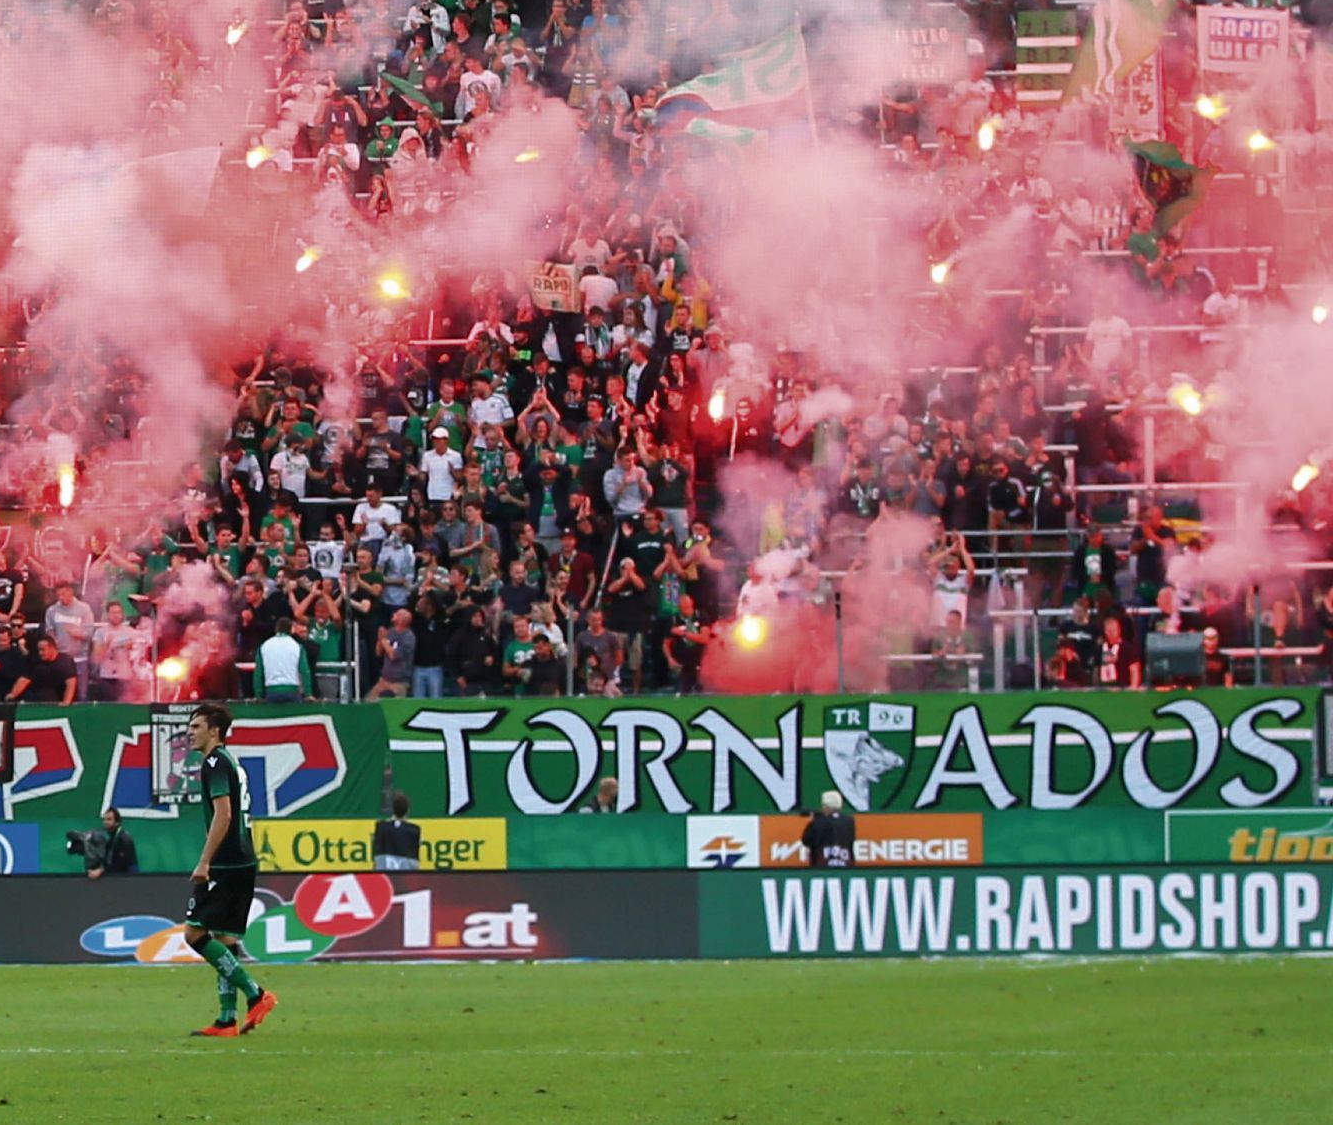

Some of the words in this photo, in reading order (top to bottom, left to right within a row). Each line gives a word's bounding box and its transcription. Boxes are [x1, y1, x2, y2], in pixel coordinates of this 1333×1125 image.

[1210, 17, 1279, 39] RAPID
[831, 708, 861, 725] TR
[291, 830, 486, 869] Ottanger
[853, 838, 969, 860] ENERGIE
[761, 872, 1333, 952] WWW.RAPIDSHOP.
